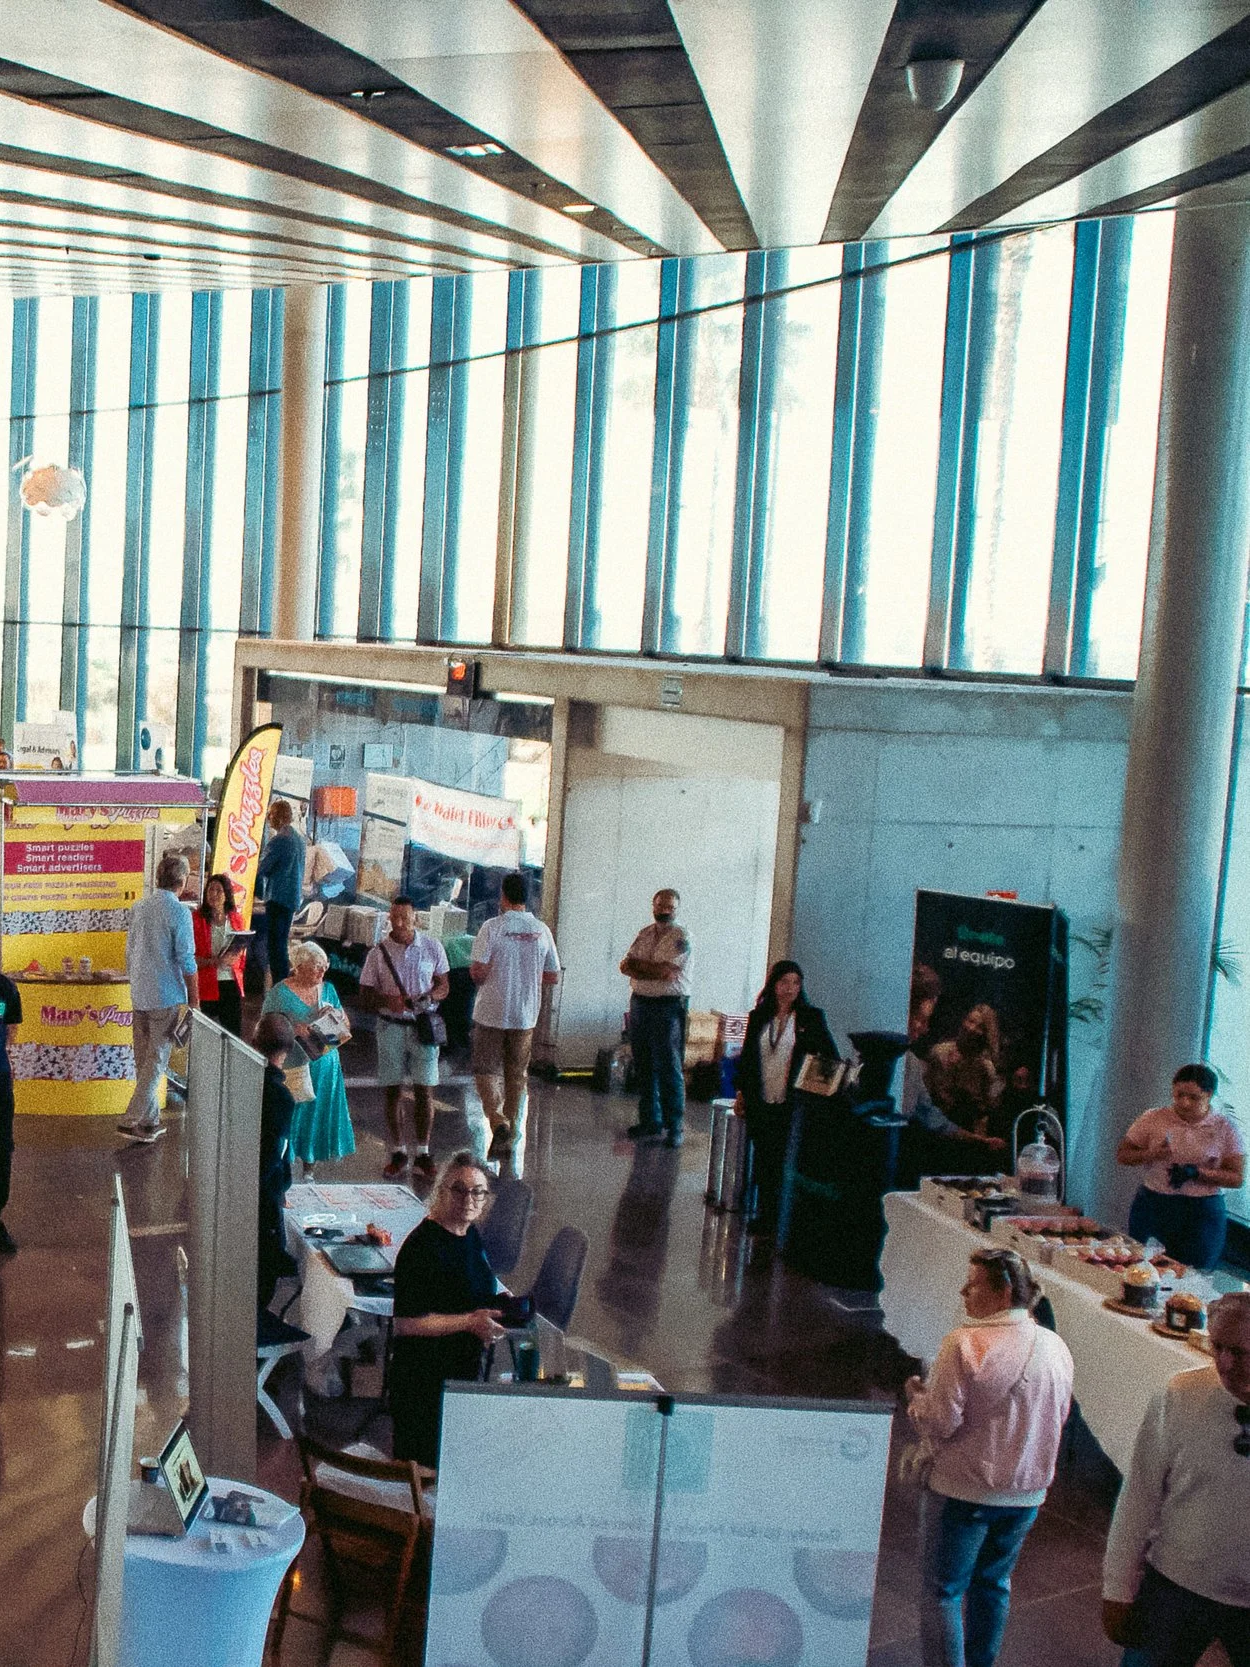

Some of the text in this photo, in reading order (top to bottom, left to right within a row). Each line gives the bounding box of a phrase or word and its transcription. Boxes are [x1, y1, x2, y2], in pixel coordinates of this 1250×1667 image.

[227, 746, 267, 859] Puzzles
[55, 806, 160, 823] Mary's Puzzles
[25, 843, 95, 855] Smart puzzles
[25, 852, 95, 863] Smart readers
[16, 862, 103, 873] Smart advertisers
[944, 946, 1016, 970] al equipo
[40, 1003, 133, 1028] Mary's Puzz
